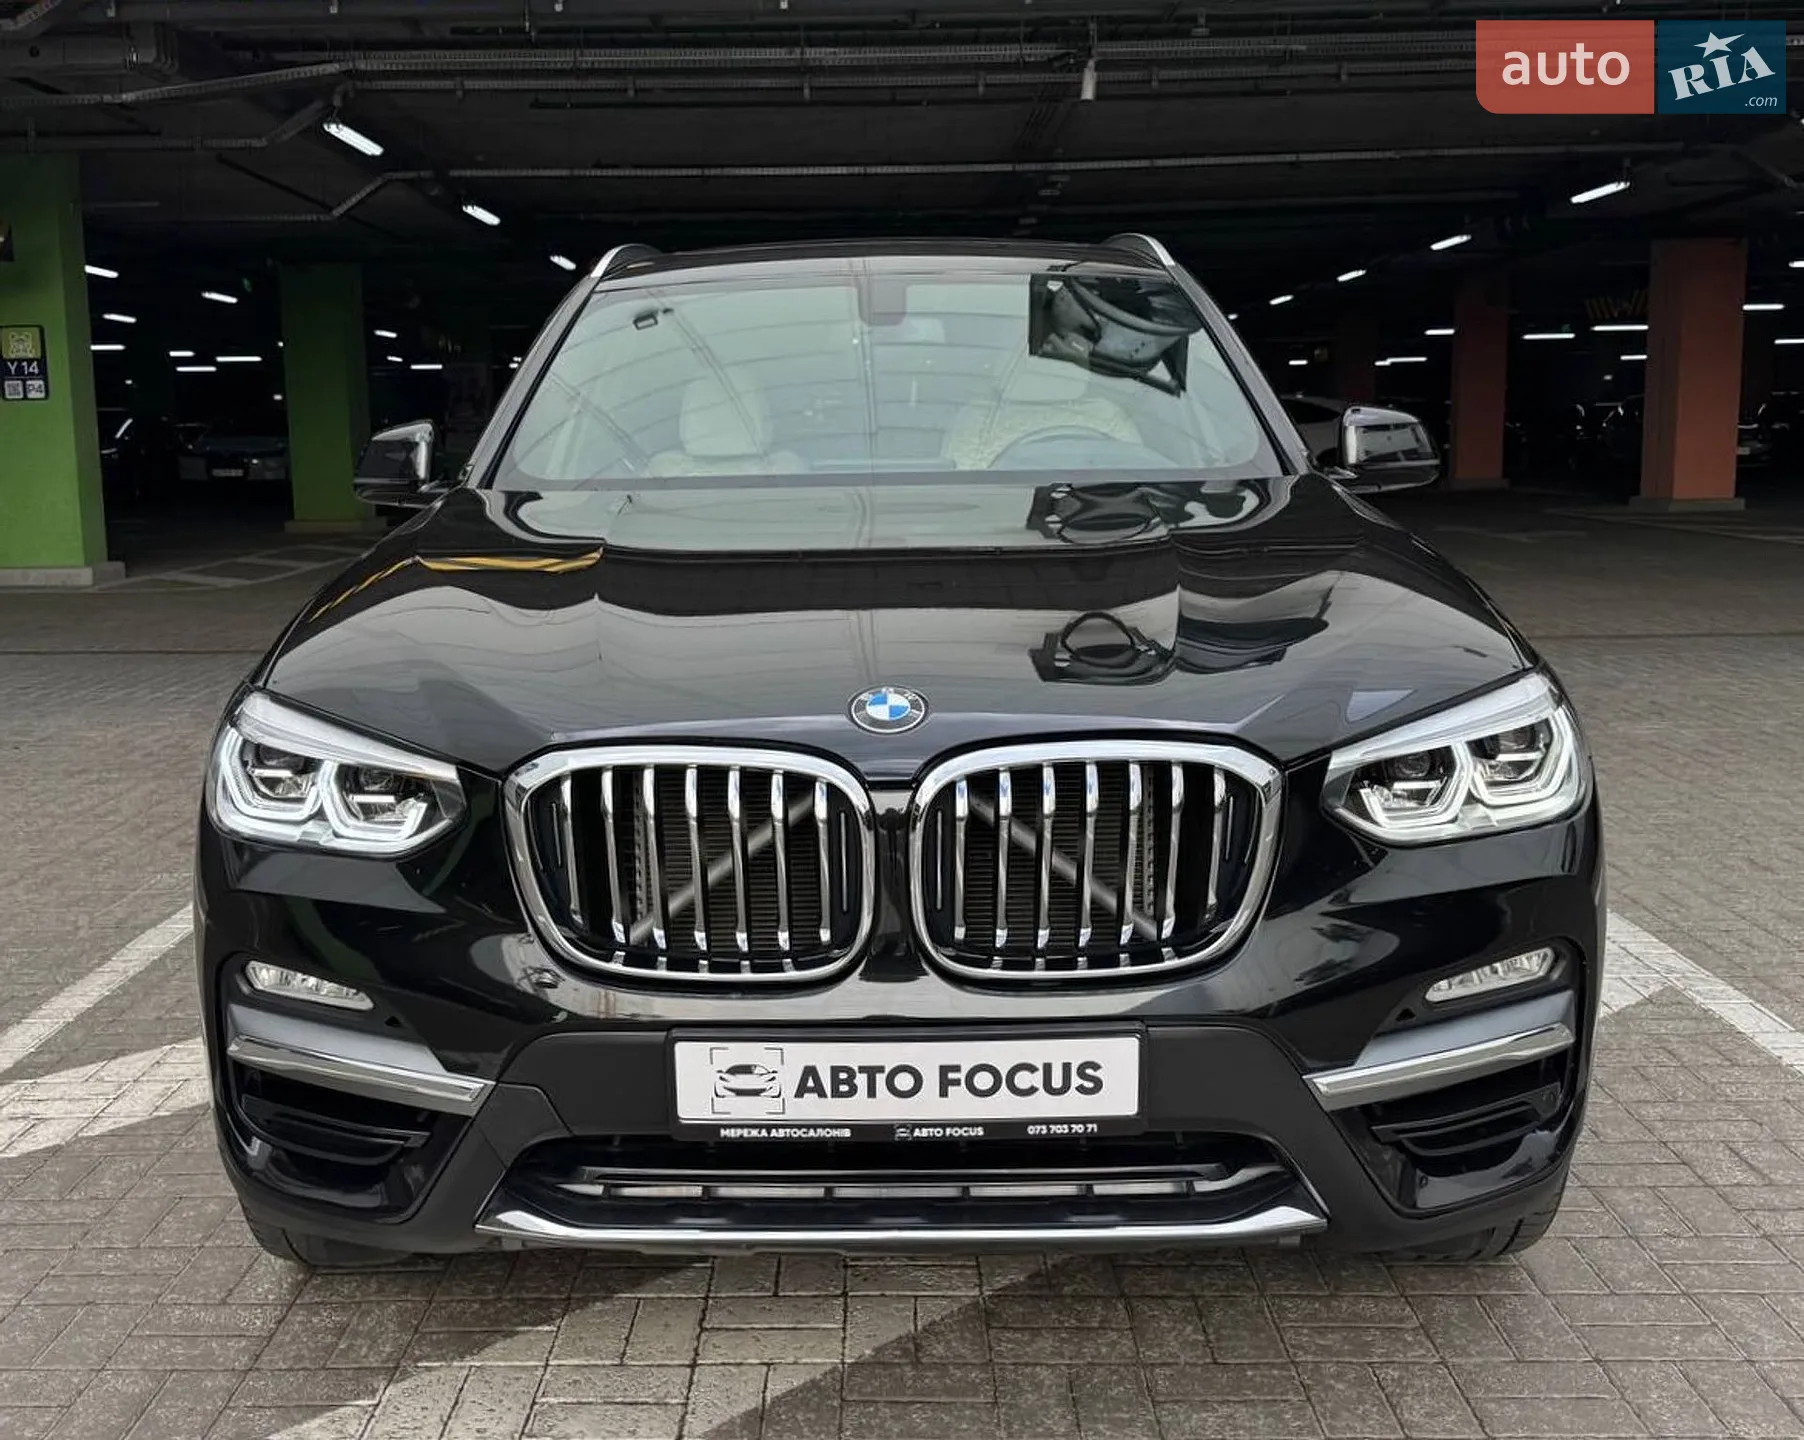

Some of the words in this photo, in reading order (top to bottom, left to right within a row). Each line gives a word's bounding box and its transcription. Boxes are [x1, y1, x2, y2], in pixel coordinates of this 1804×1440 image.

[7, 361, 17, 375] Y
[21, 361, 39, 375] 14
[794, 1064, 923, 1099] АВТО
[938, 1060, 1104, 1098] FOCUS
[720, 1128, 767, 1138] МЕРЕЖА
[913, 1127, 943, 1137] АВТО
[945, 1126, 984, 1137] FOCUS
[1027, 1125, 1047, 1135] 073
[1049, 1124, 1068, 1135] 703
[1070, 1124, 1084, 1134] 70
[1086, 1123, 1098, 1133] 71
